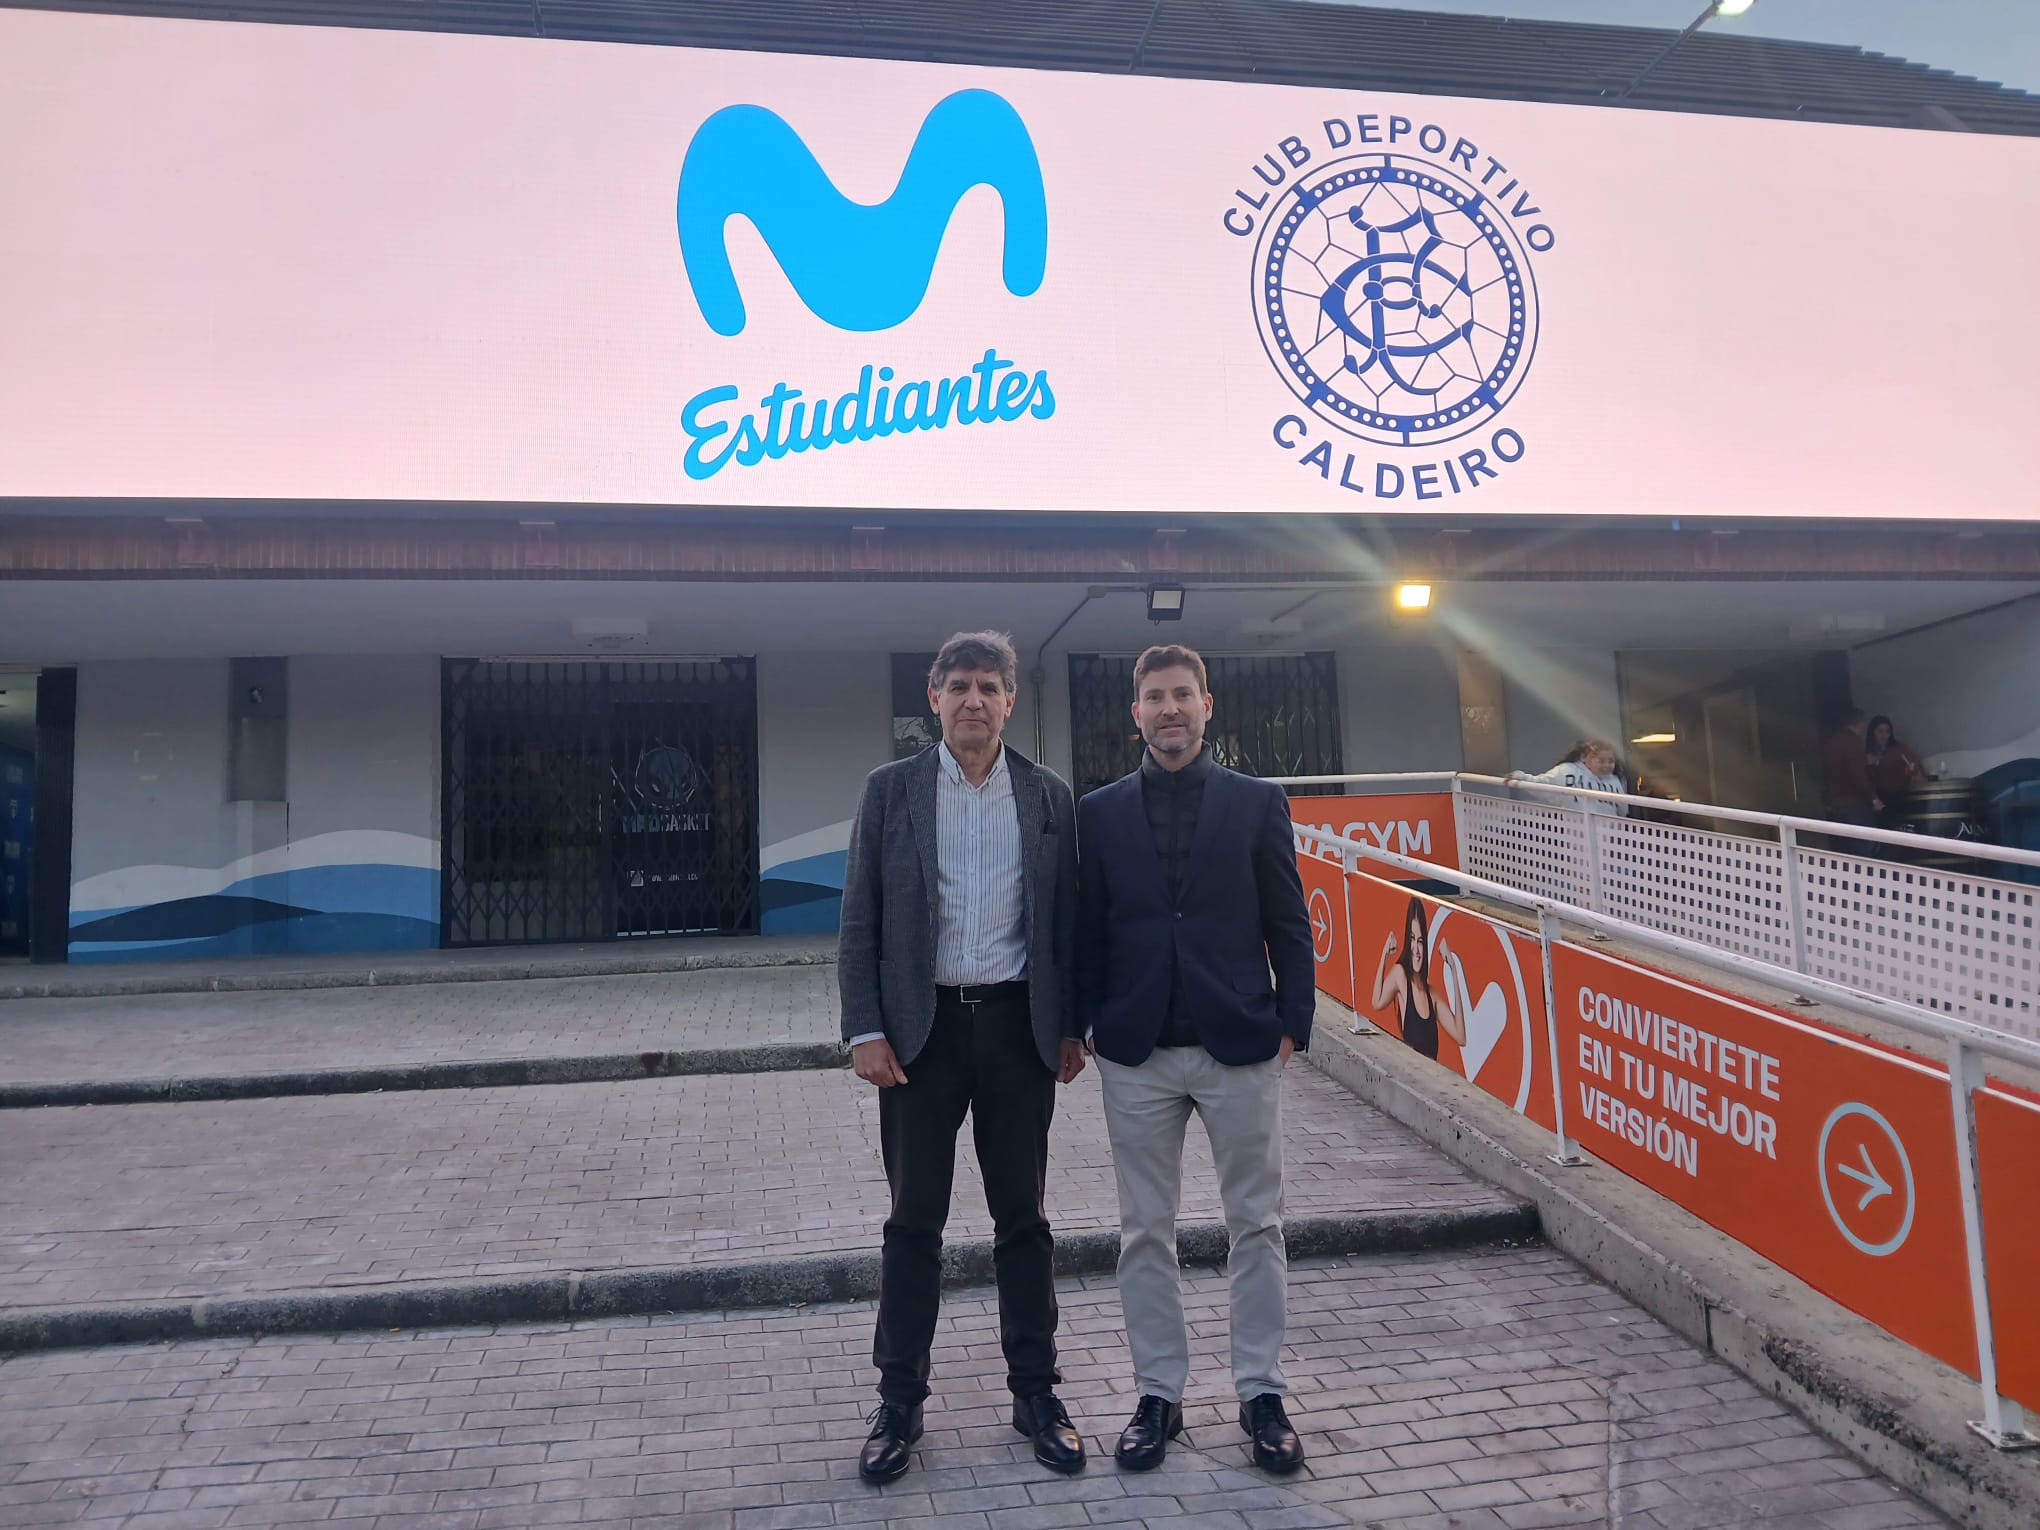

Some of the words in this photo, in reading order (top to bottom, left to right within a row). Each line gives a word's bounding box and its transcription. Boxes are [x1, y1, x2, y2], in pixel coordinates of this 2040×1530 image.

[1223, 136, 1312, 237] CLUB
[1322, 114, 1555, 252] DEPORTIVO
[681, 348, 1056, 480] Estudiantes
[1272, 414, 1525, 501] CALDEIRO
[1578, 986, 1781, 1101] CONVIERTETE
[1578, 1032, 1613, 1081] EN
[1619, 1050, 1656, 1100] TU
[1663, 1069, 1777, 1160] MEJOR
[1579, 1080, 1699, 1178] VERSIÓN
